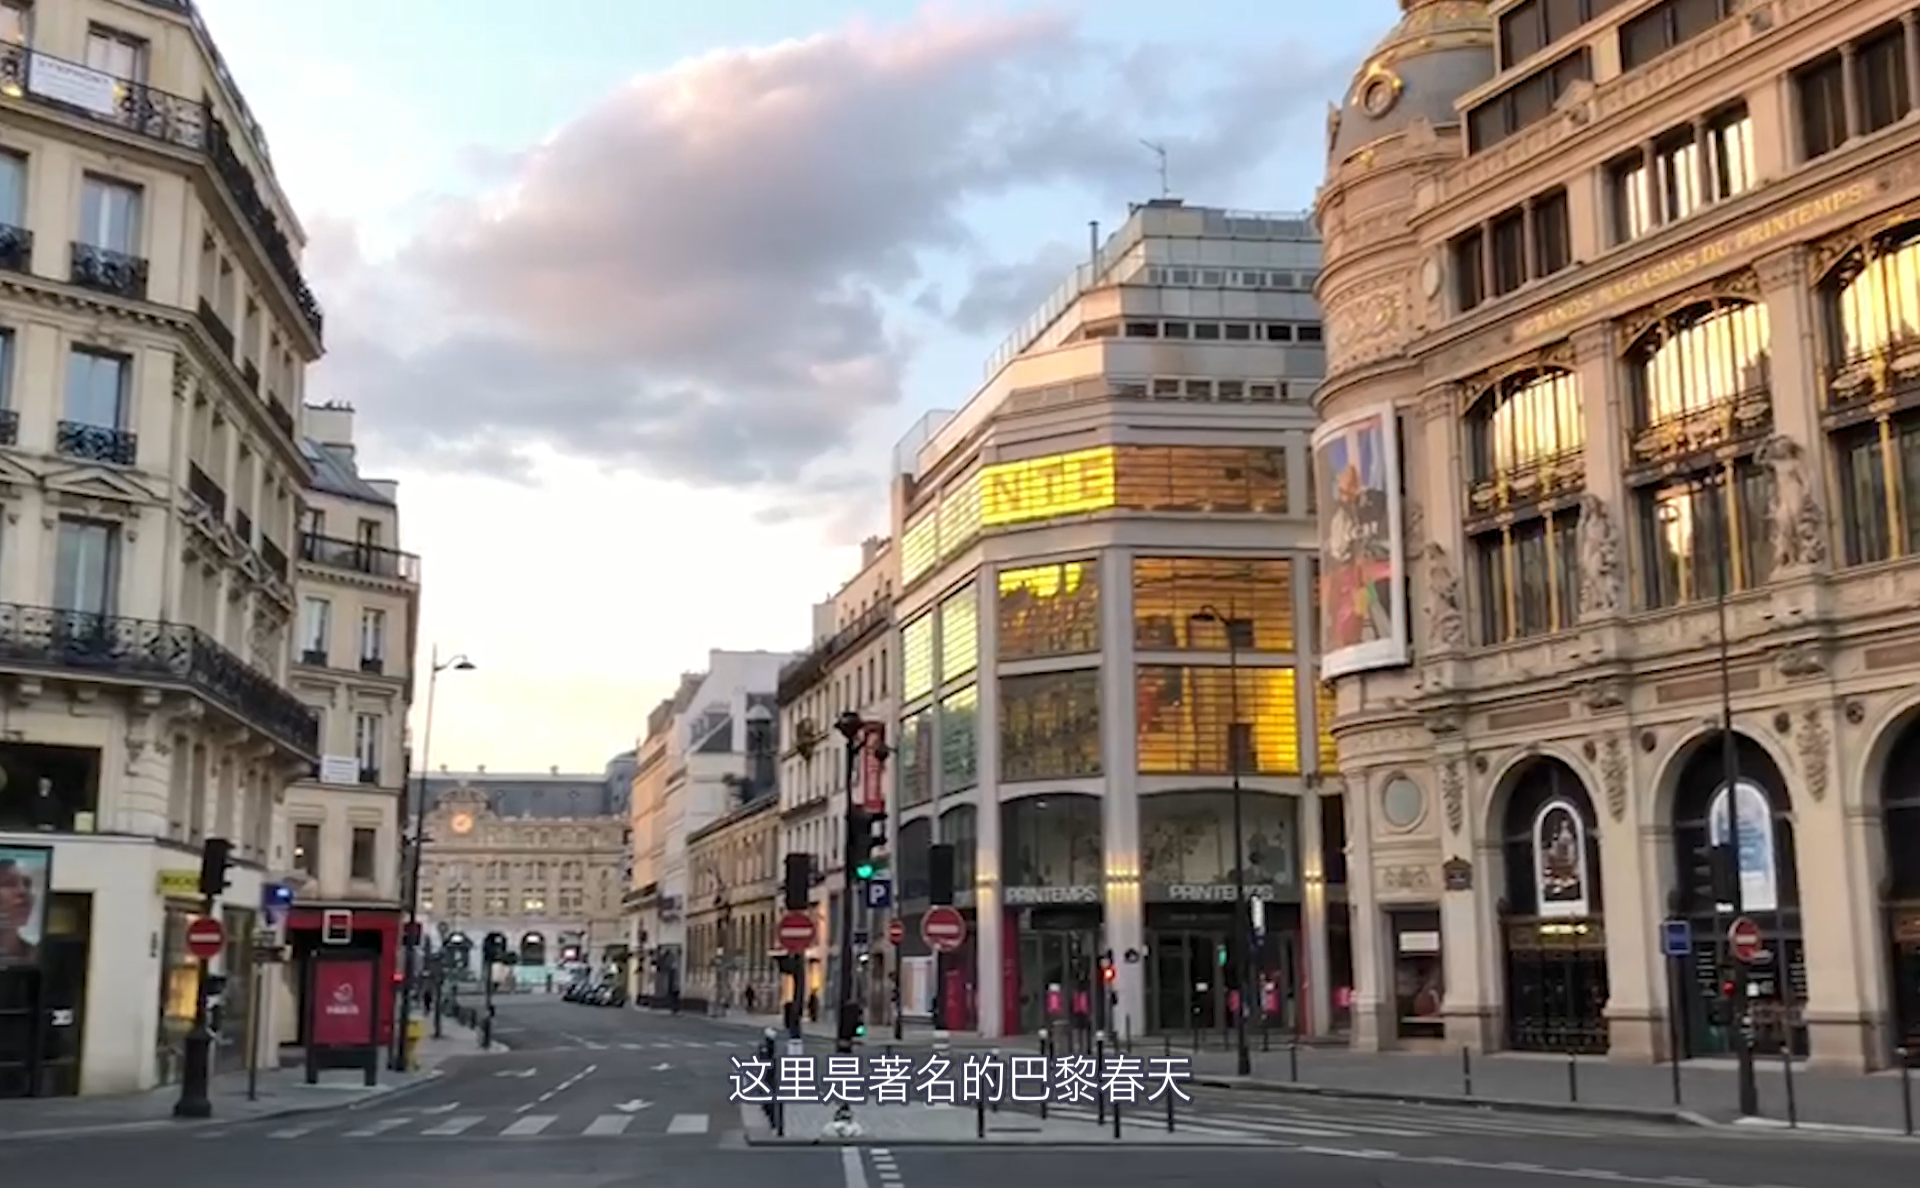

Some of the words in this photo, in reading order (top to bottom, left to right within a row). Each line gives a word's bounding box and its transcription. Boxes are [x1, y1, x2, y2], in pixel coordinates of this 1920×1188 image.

[1736, 184, 1866, 249] PRINTEMPS
[869, 884, 886, 904] P
[1005, 885, 1098, 904] PRINTEMPS
